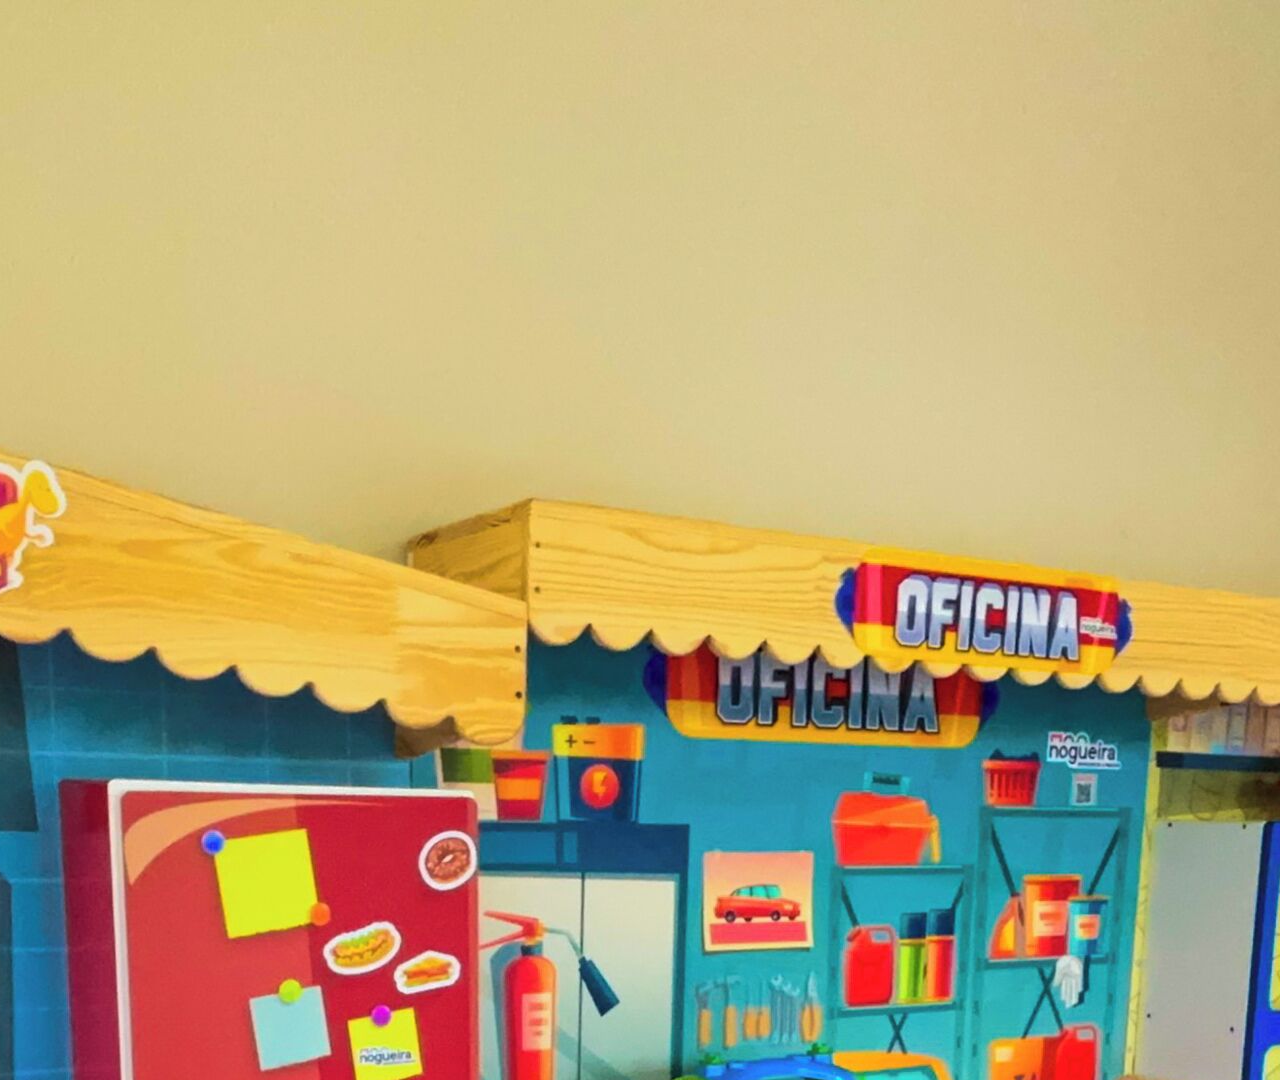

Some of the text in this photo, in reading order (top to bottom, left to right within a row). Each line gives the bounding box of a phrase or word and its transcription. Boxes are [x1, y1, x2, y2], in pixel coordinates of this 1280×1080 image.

[895, 574, 1080, 661] OFICINA
[717, 650, 939, 733] OFICINA
[1049, 742, 1116, 765] nogueira
[360, 1050, 411, 1065] nogueira
